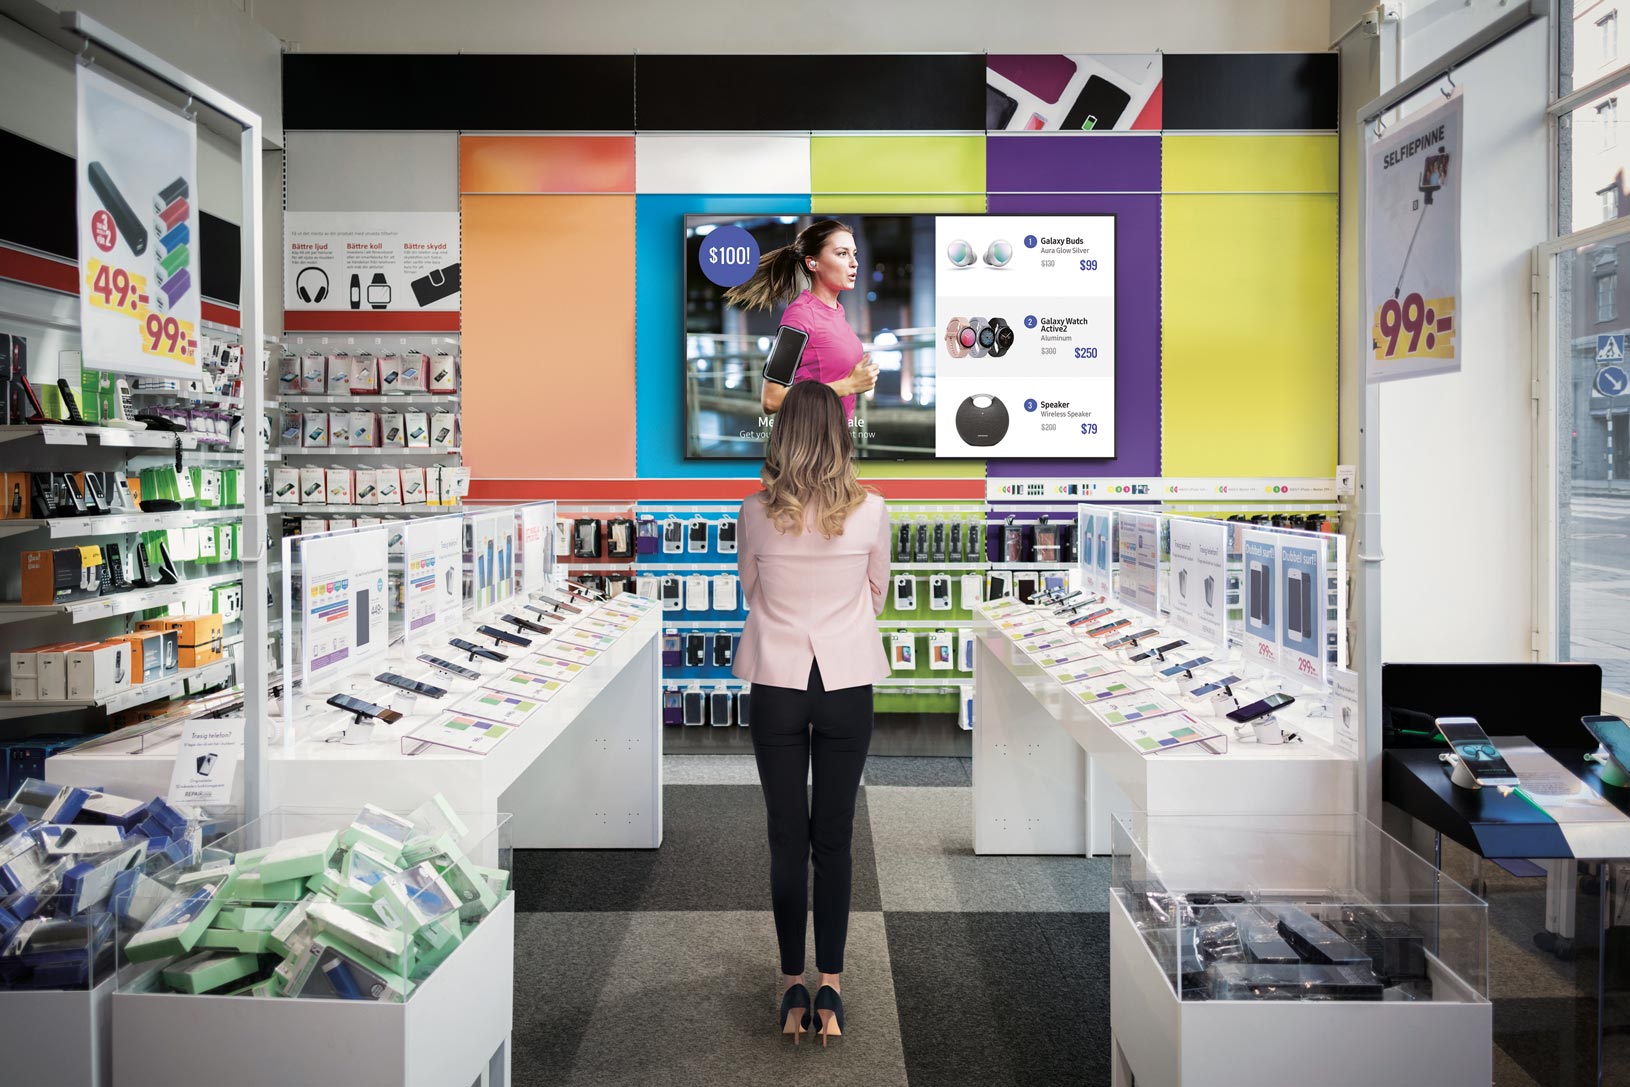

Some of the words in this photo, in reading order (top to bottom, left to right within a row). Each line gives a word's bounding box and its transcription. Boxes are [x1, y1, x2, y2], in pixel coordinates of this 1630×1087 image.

[1383, 125, 1445, 170] SELFIEPINNE
[314, 243, 328, 251] ljud
[426, 242, 447, 251] skydd
[1040, 237, 1065, 246] Galaxy
[708, 246, 750, 266] $100!
[1080, 259, 1097, 271] $99
[1040, 317, 1065, 326] Galaxy
[1380, 292, 1452, 357] 99:-
[146, 314, 197, 356] 99:-
[1074, 347, 1098, 359] $250
[1040, 401, 1070, 409] Speaker
[848, 416, 865, 427] ale
[739, 430, 753, 439] Get
[1081, 422, 1098, 435] $79
[1246, 543, 1262, 556] Dubbel
[1282, 550, 1302, 563] Dubbel
